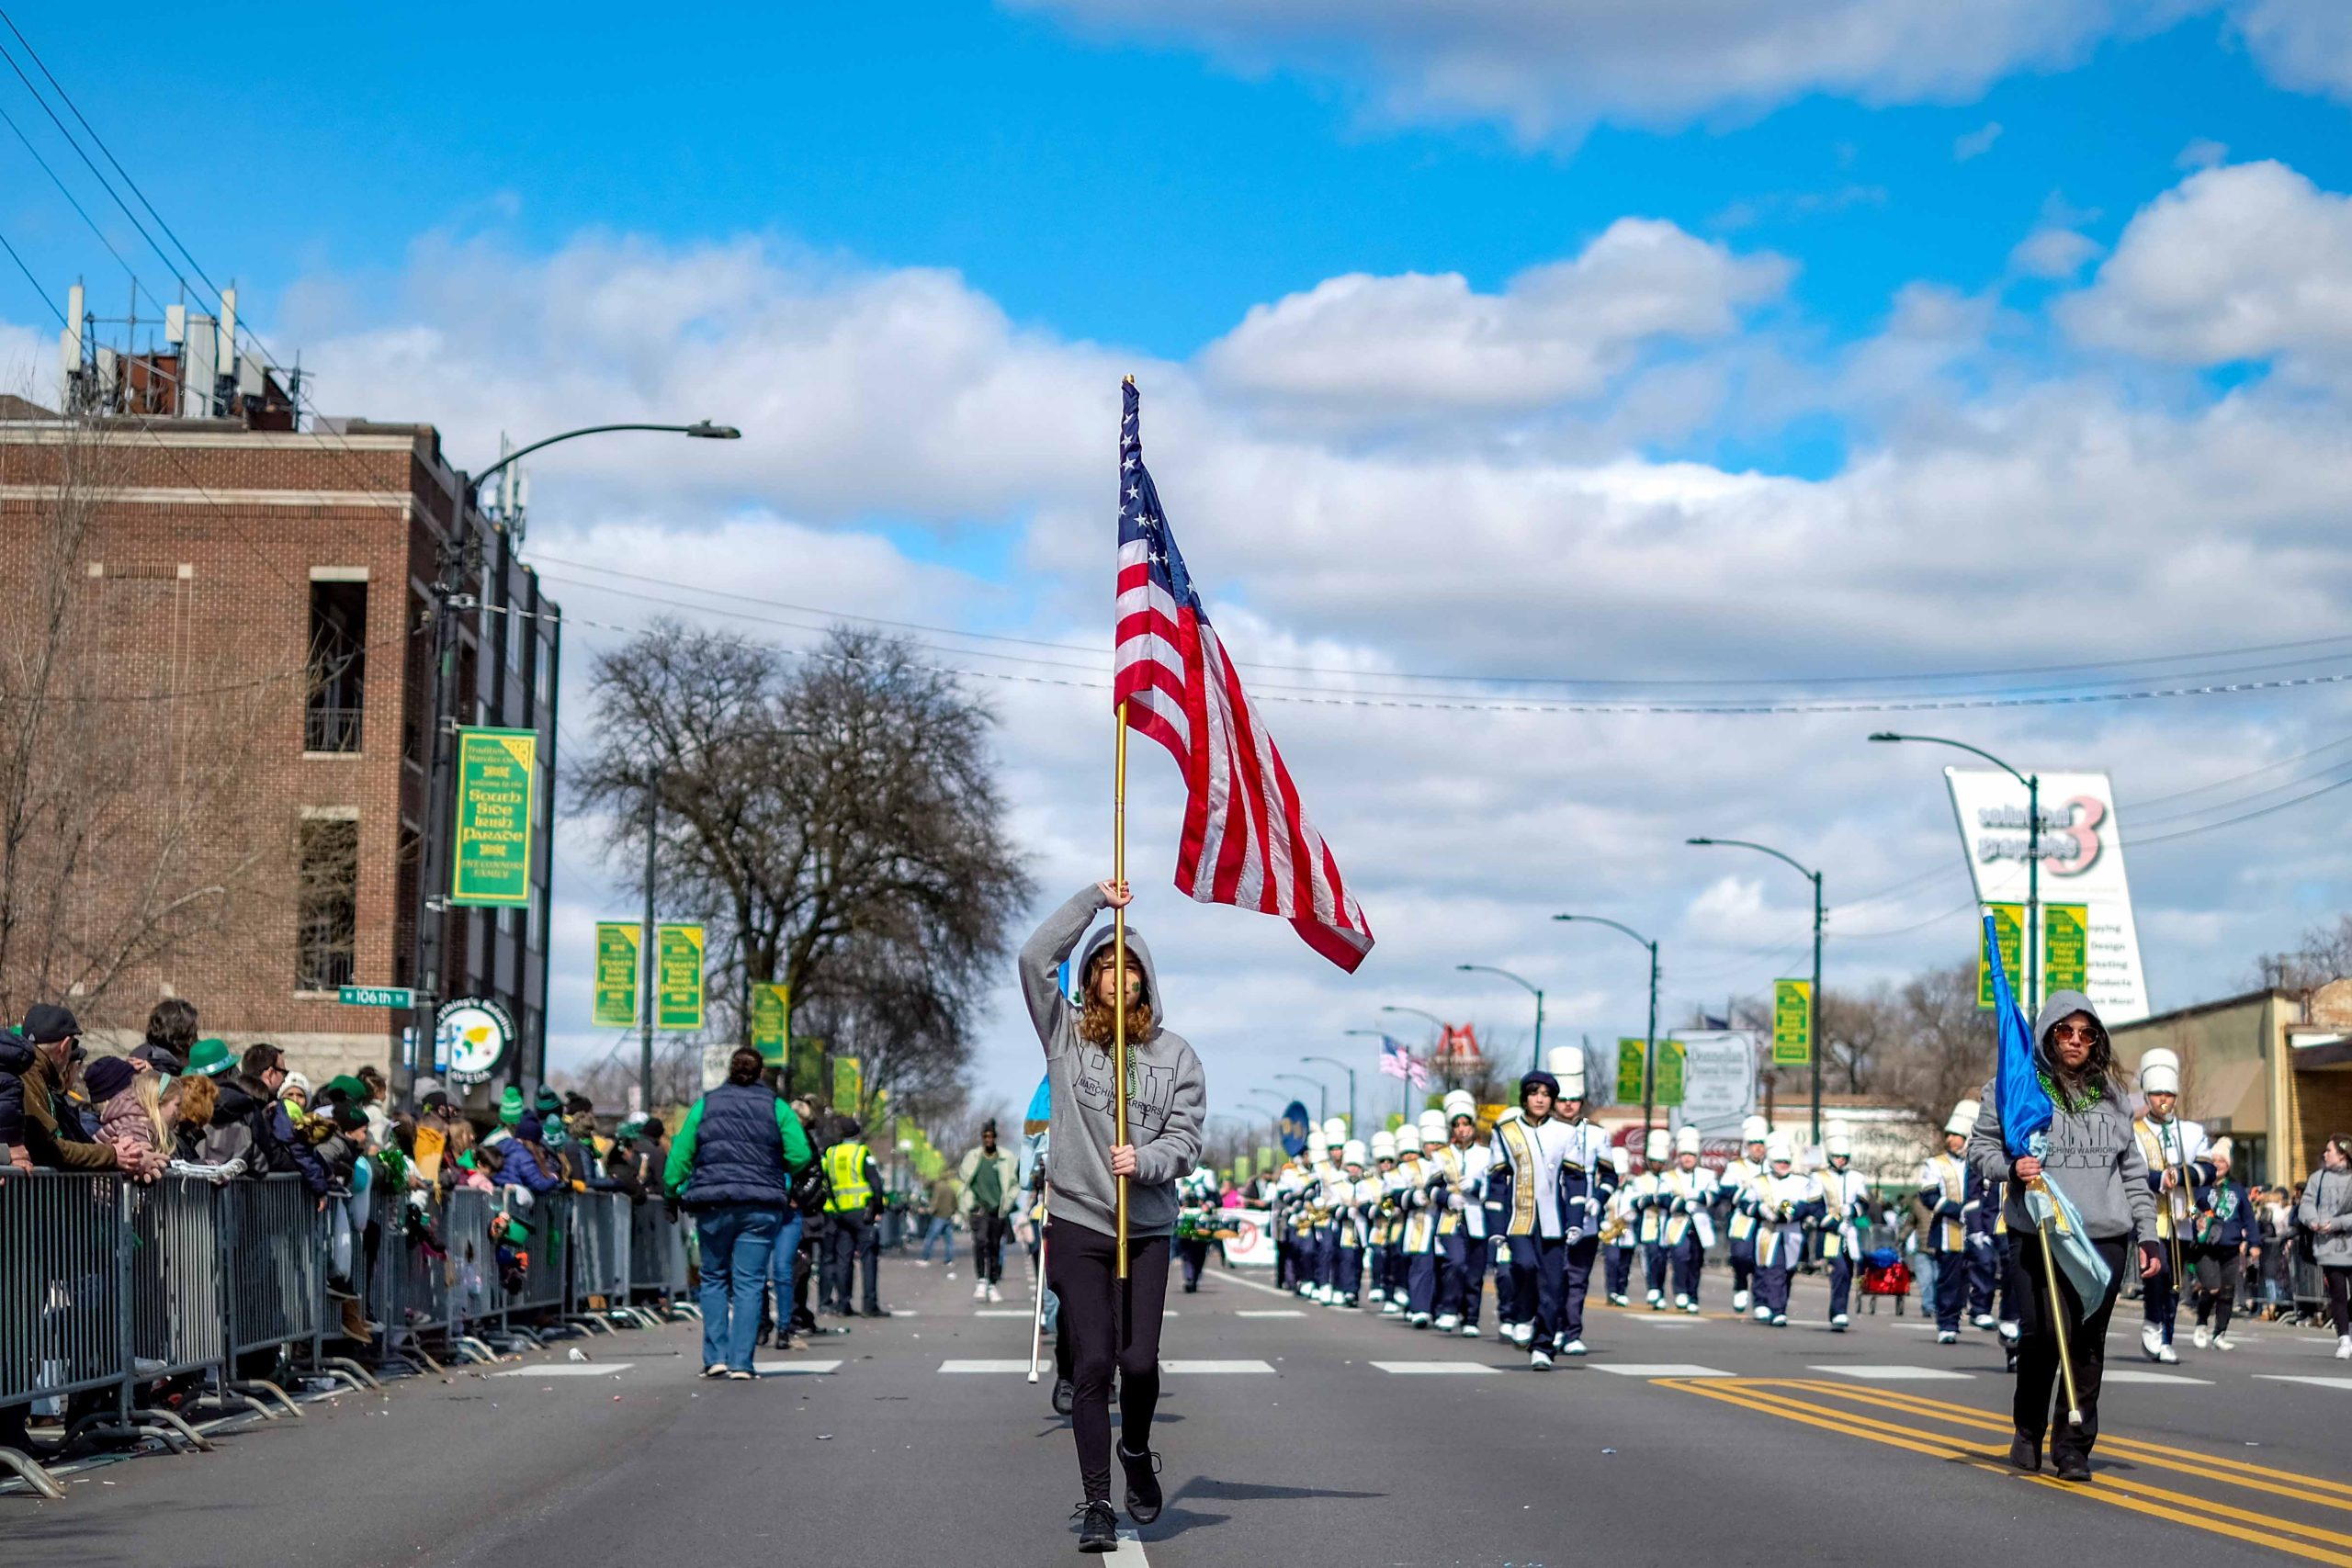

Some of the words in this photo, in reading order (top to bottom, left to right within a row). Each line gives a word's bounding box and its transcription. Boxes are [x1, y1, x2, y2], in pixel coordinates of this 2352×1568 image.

[477, 802, 513, 815] Side
[2045, 795, 2108, 877] 3
[356, 989, 391, 1005] 106th
[1079, 1077, 1116, 1100] MARCHIN
[2047, 1145, 2076, 1155] RCHING
